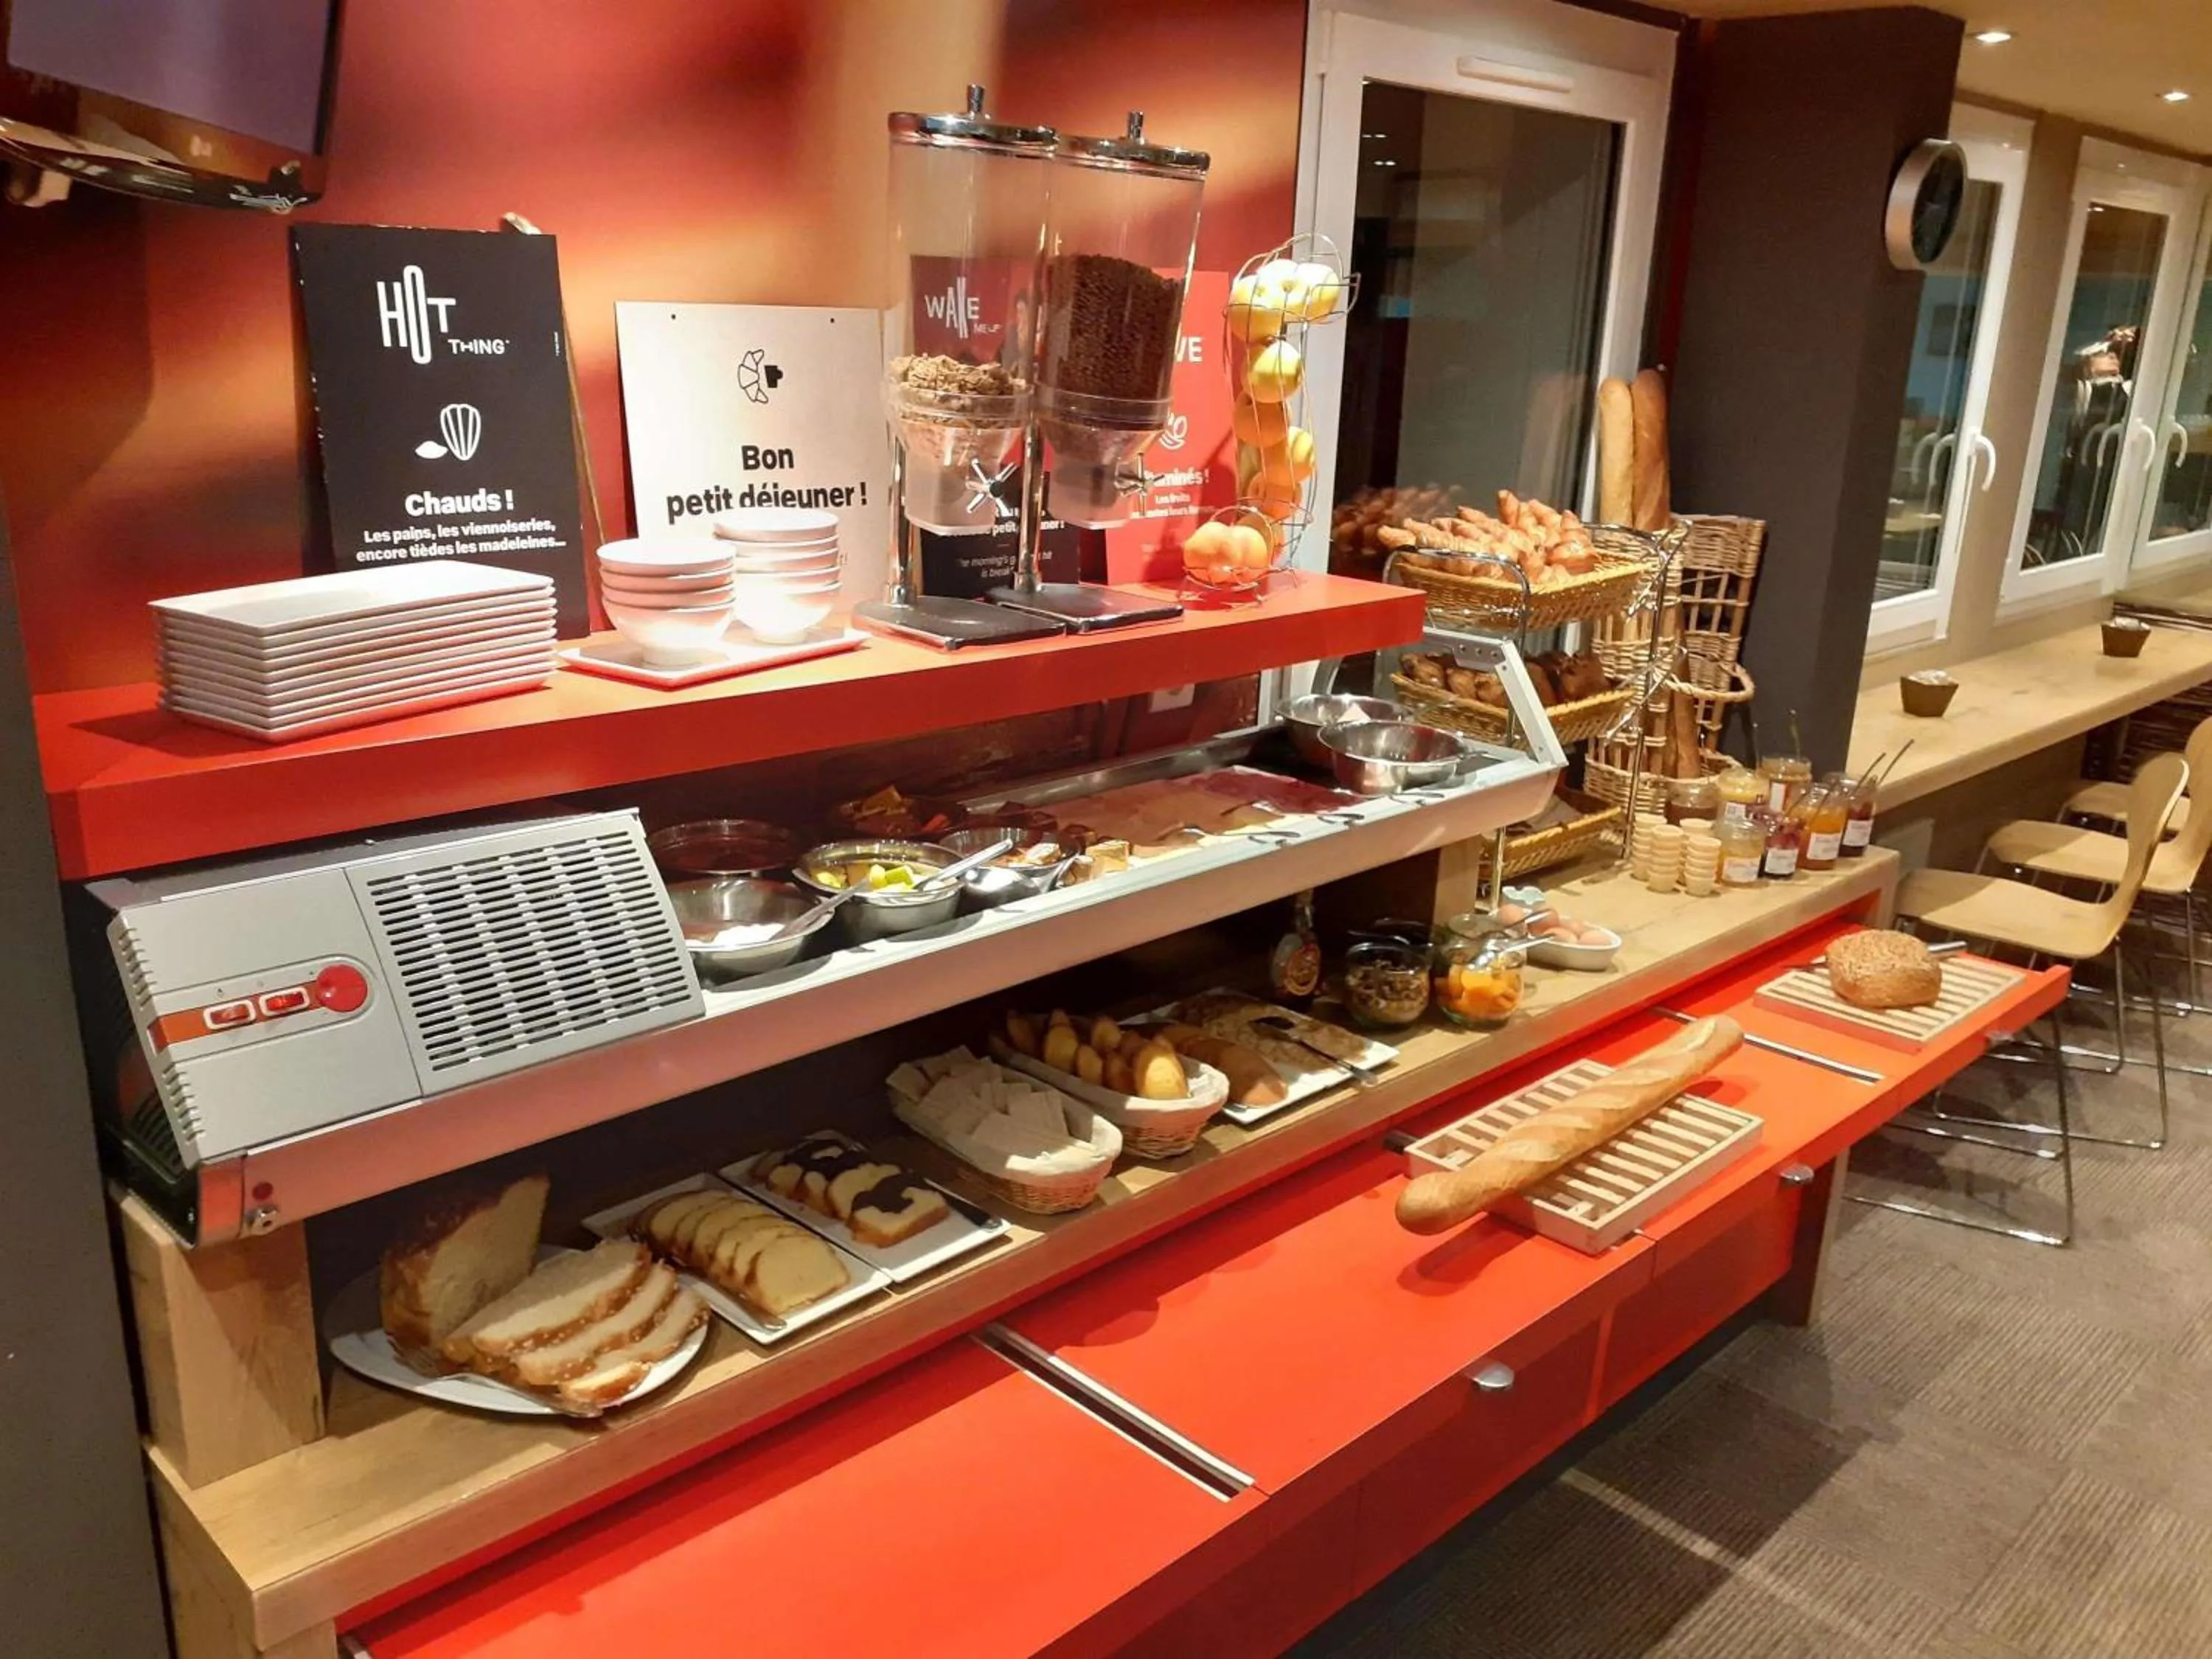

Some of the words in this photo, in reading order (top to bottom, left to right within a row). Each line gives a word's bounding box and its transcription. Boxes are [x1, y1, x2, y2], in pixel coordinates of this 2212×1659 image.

[377, 265, 456, 364] HOT
[925, 276, 979, 338] WAKE
[1177, 336, 1203, 363] VE
[741, 445, 794, 470] Bon
[405, 487, 501, 516] Chauds
[667, 485, 734, 525] petit
[364, 530, 391, 543] Les
[393, 526, 437, 544] pains,
[437, 524, 459, 538] les
[462, 518, 556, 537] viennoiseries,
[355, 548, 407, 562] encore
[409, 543, 455, 558] tièdes
[455, 540, 477, 554] les
